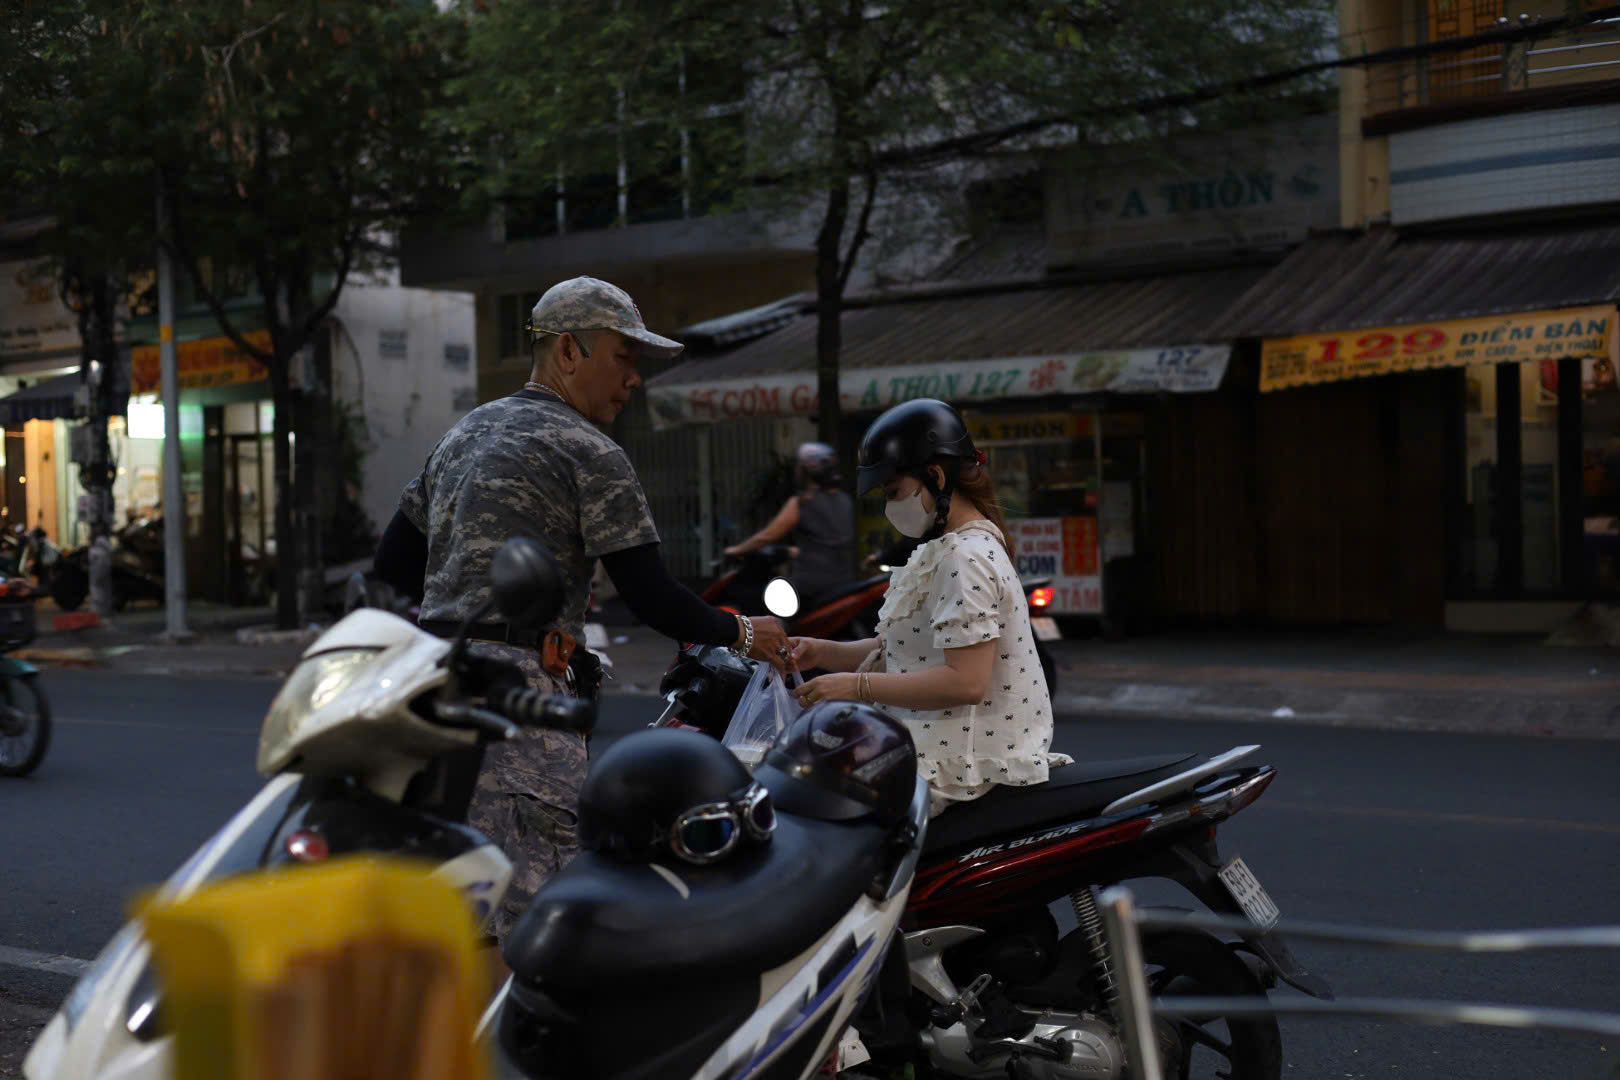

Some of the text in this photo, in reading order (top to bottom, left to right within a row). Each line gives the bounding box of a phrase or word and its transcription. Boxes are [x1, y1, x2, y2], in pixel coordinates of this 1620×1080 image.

[1314, 328, 1447, 364] 129
[970, 367, 1021, 396] 127
[958, 823, 1089, 864] AIR BLADE
